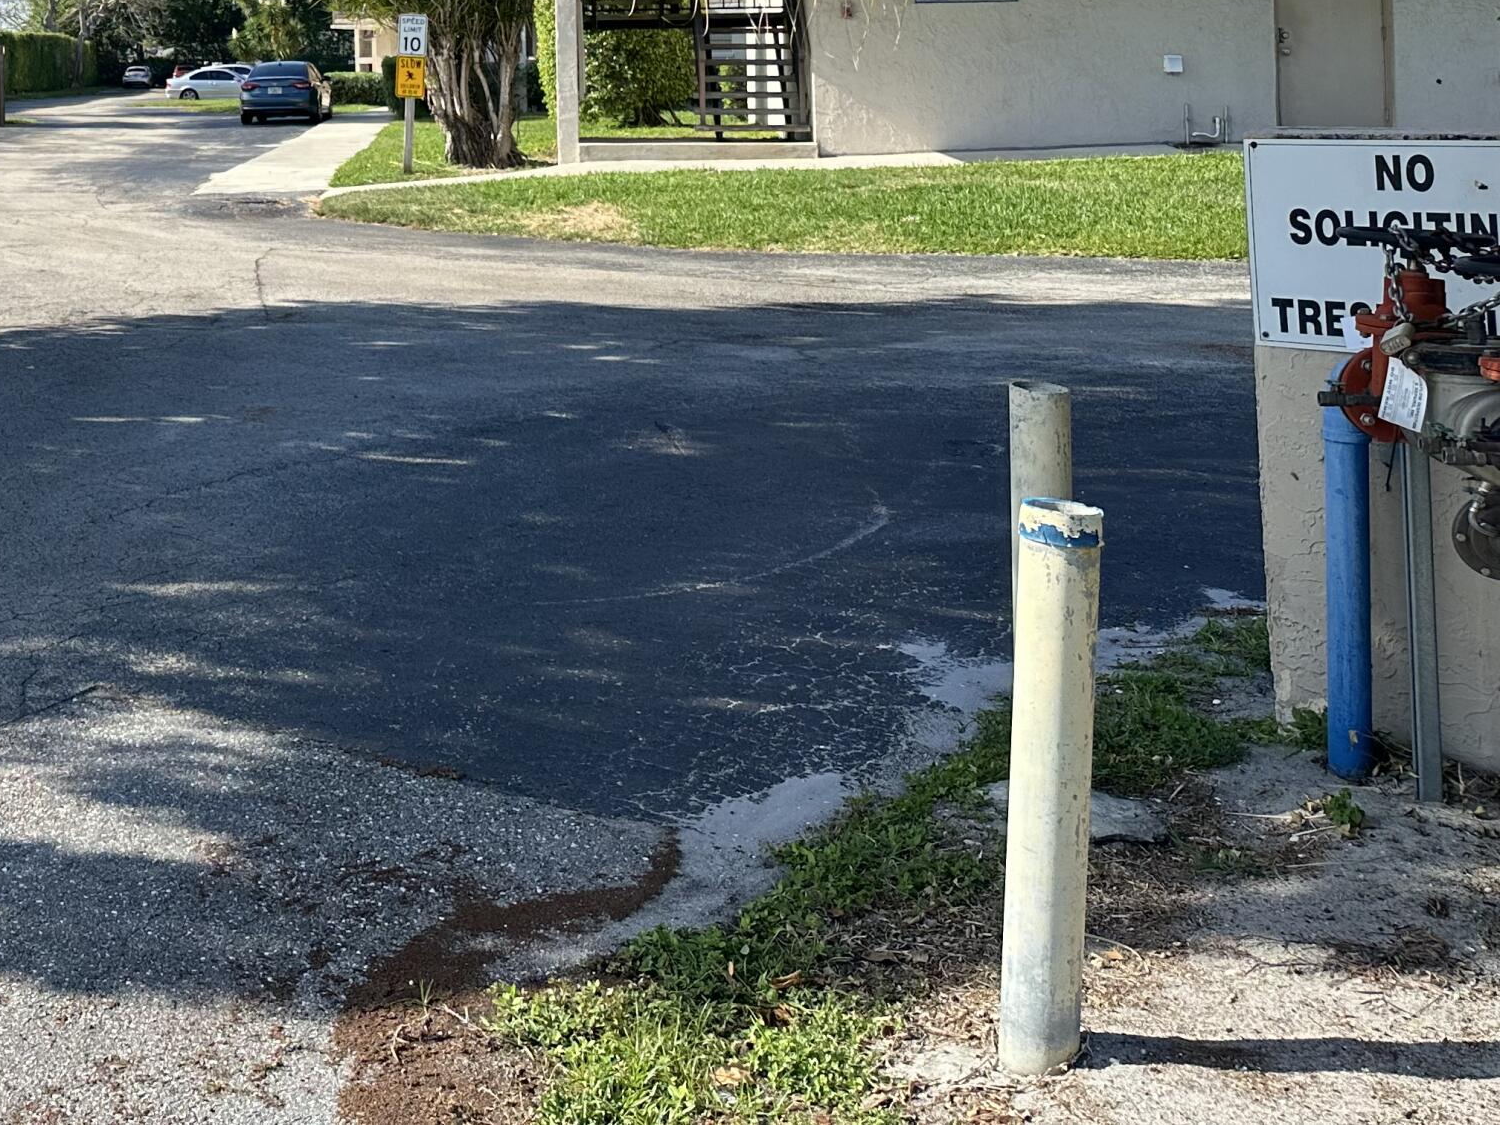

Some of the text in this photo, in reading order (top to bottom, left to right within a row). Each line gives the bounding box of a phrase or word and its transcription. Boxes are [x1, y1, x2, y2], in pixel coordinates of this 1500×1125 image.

[403, 36, 421, 52] 10
[400, 58, 421, 69] SLOW
[1374, 154, 1435, 192] NO
